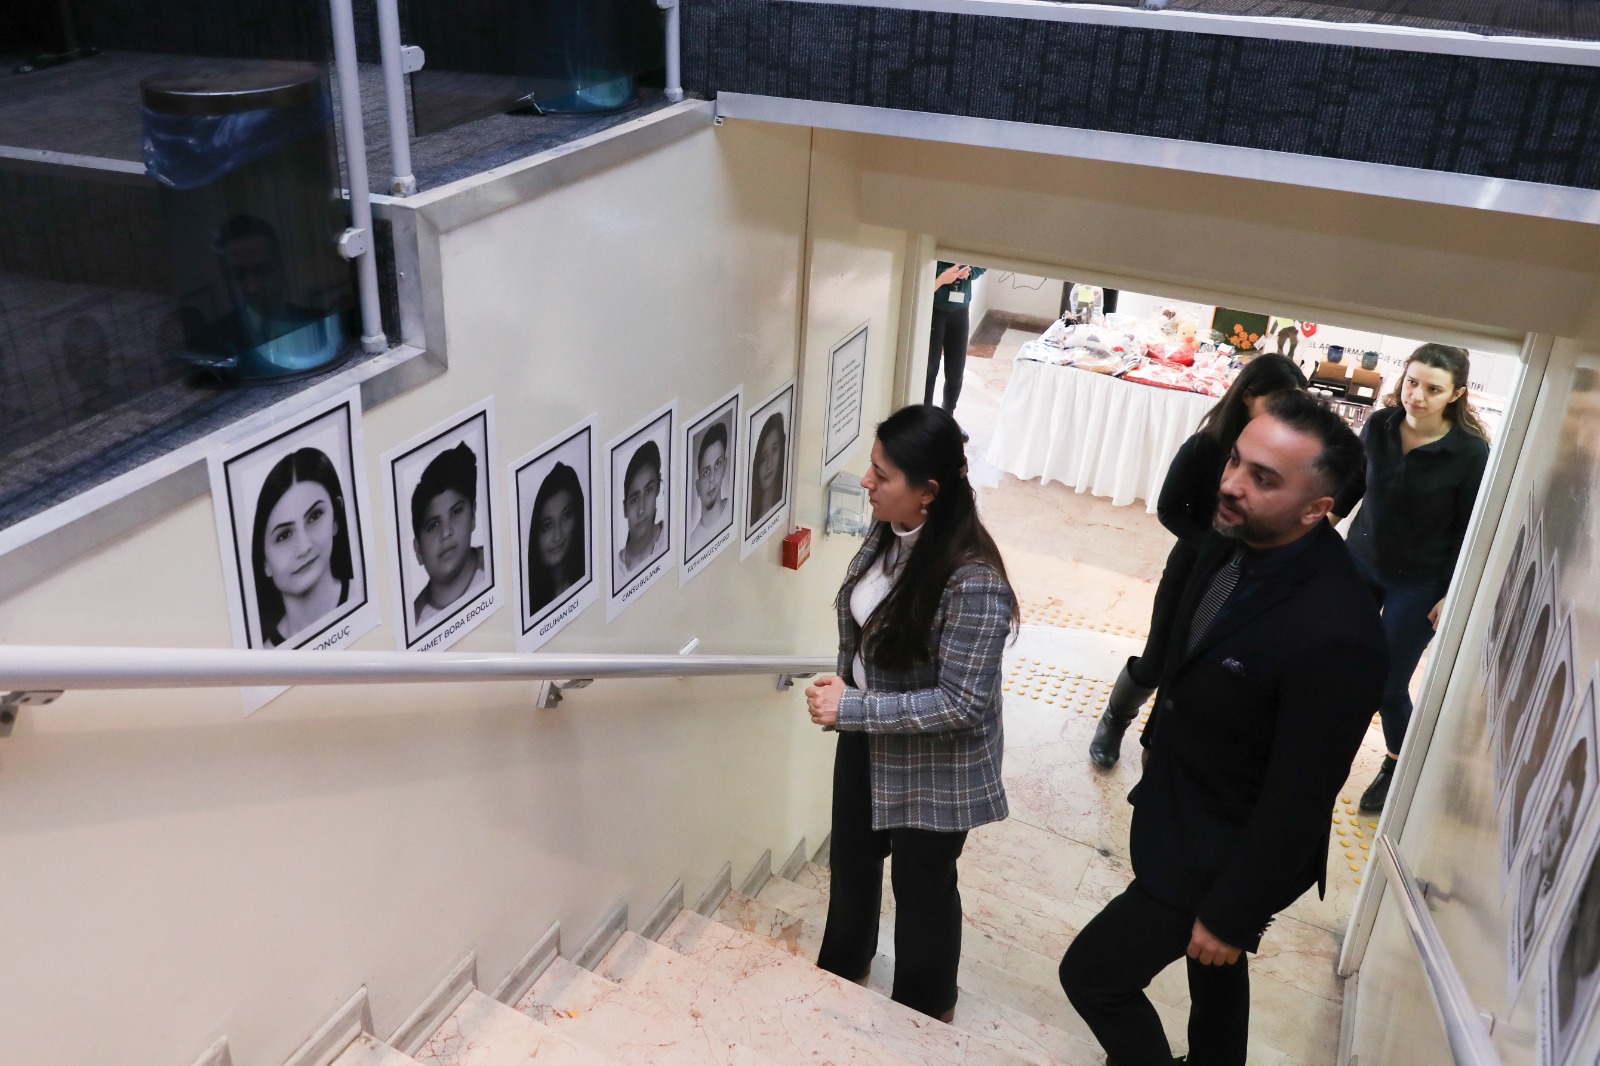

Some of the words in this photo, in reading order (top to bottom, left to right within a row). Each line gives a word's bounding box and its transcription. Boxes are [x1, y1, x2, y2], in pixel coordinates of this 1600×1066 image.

[1319, 343, 1365, 356] ARIRMA
[622, 582, 639, 602] CANSU
[444, 618, 466, 639] BORA
[466, 595, 494, 622] EROĞLU
